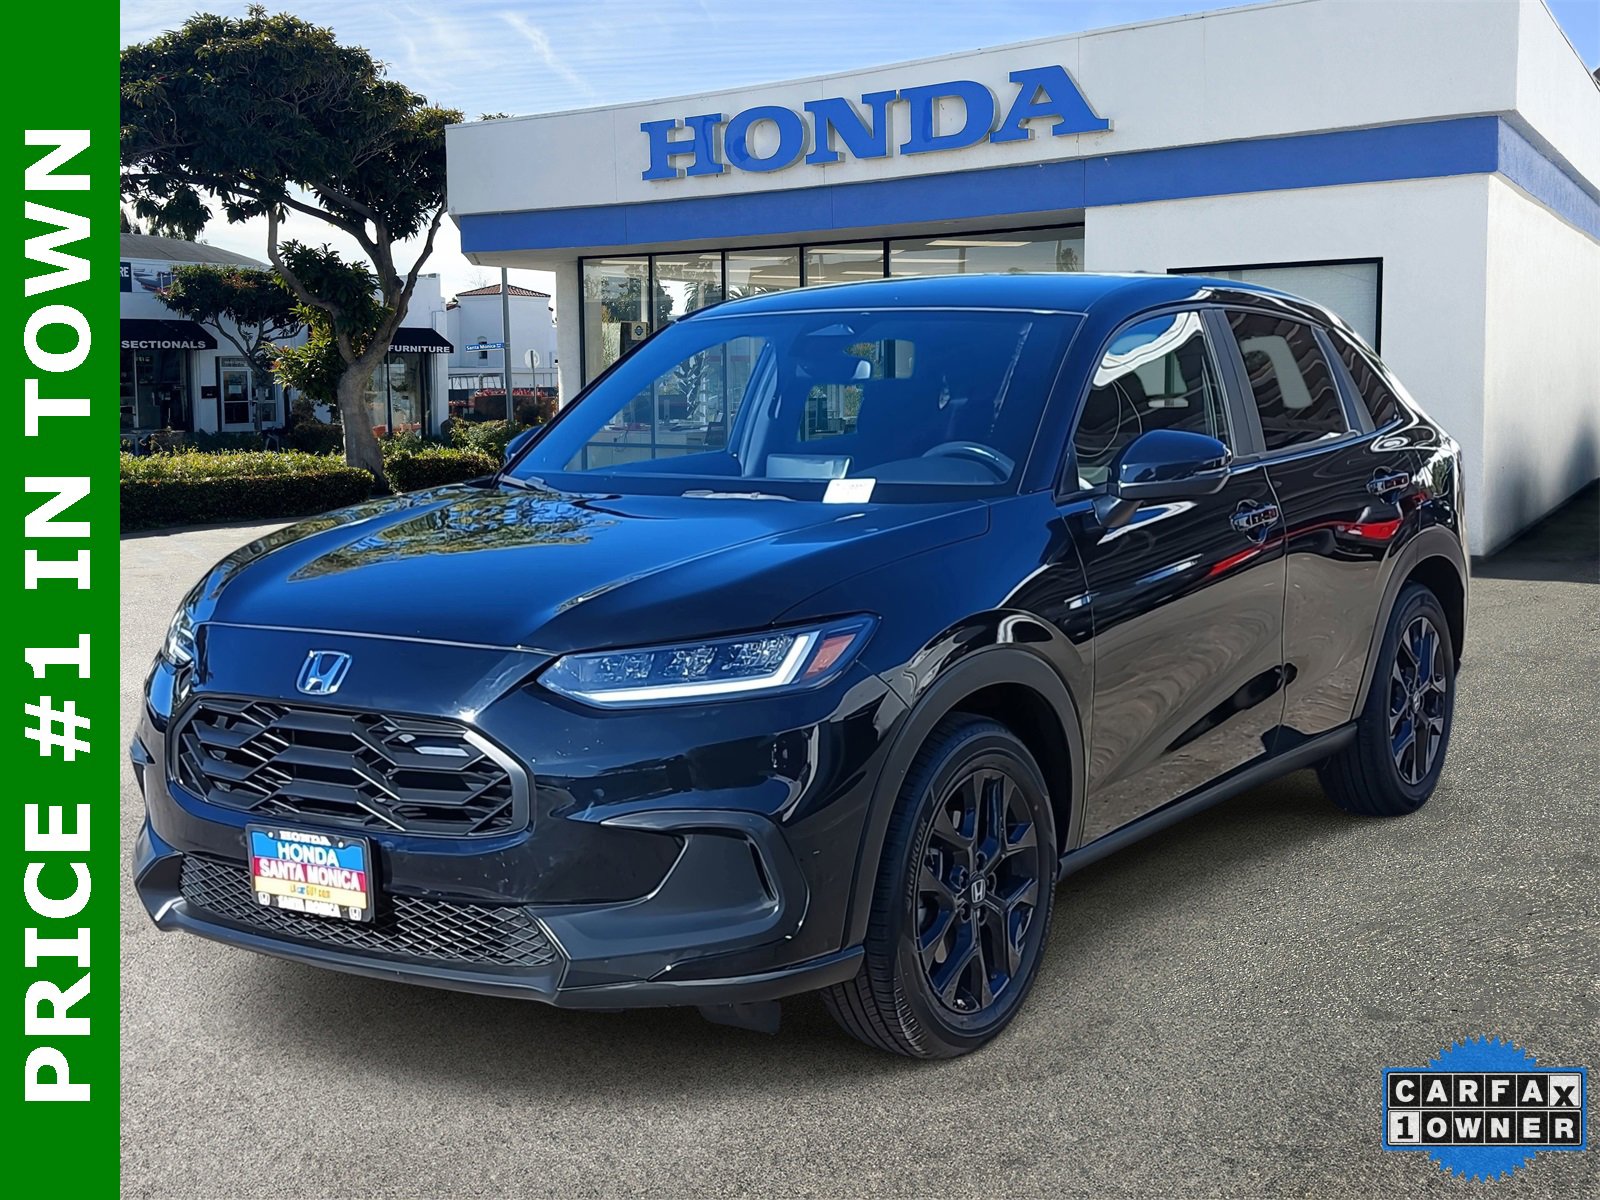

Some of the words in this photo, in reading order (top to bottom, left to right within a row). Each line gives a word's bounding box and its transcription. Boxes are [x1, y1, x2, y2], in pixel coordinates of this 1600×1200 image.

[640, 64, 1113, 182] HONDA
[121, 340, 206, 349] SECTIONALS
[388, 344, 451, 353] FURNITURE
[277, 841, 340, 868] HONDA
[260, 858, 305, 883] SANTA
[306, 863, 361, 892] MONICA
